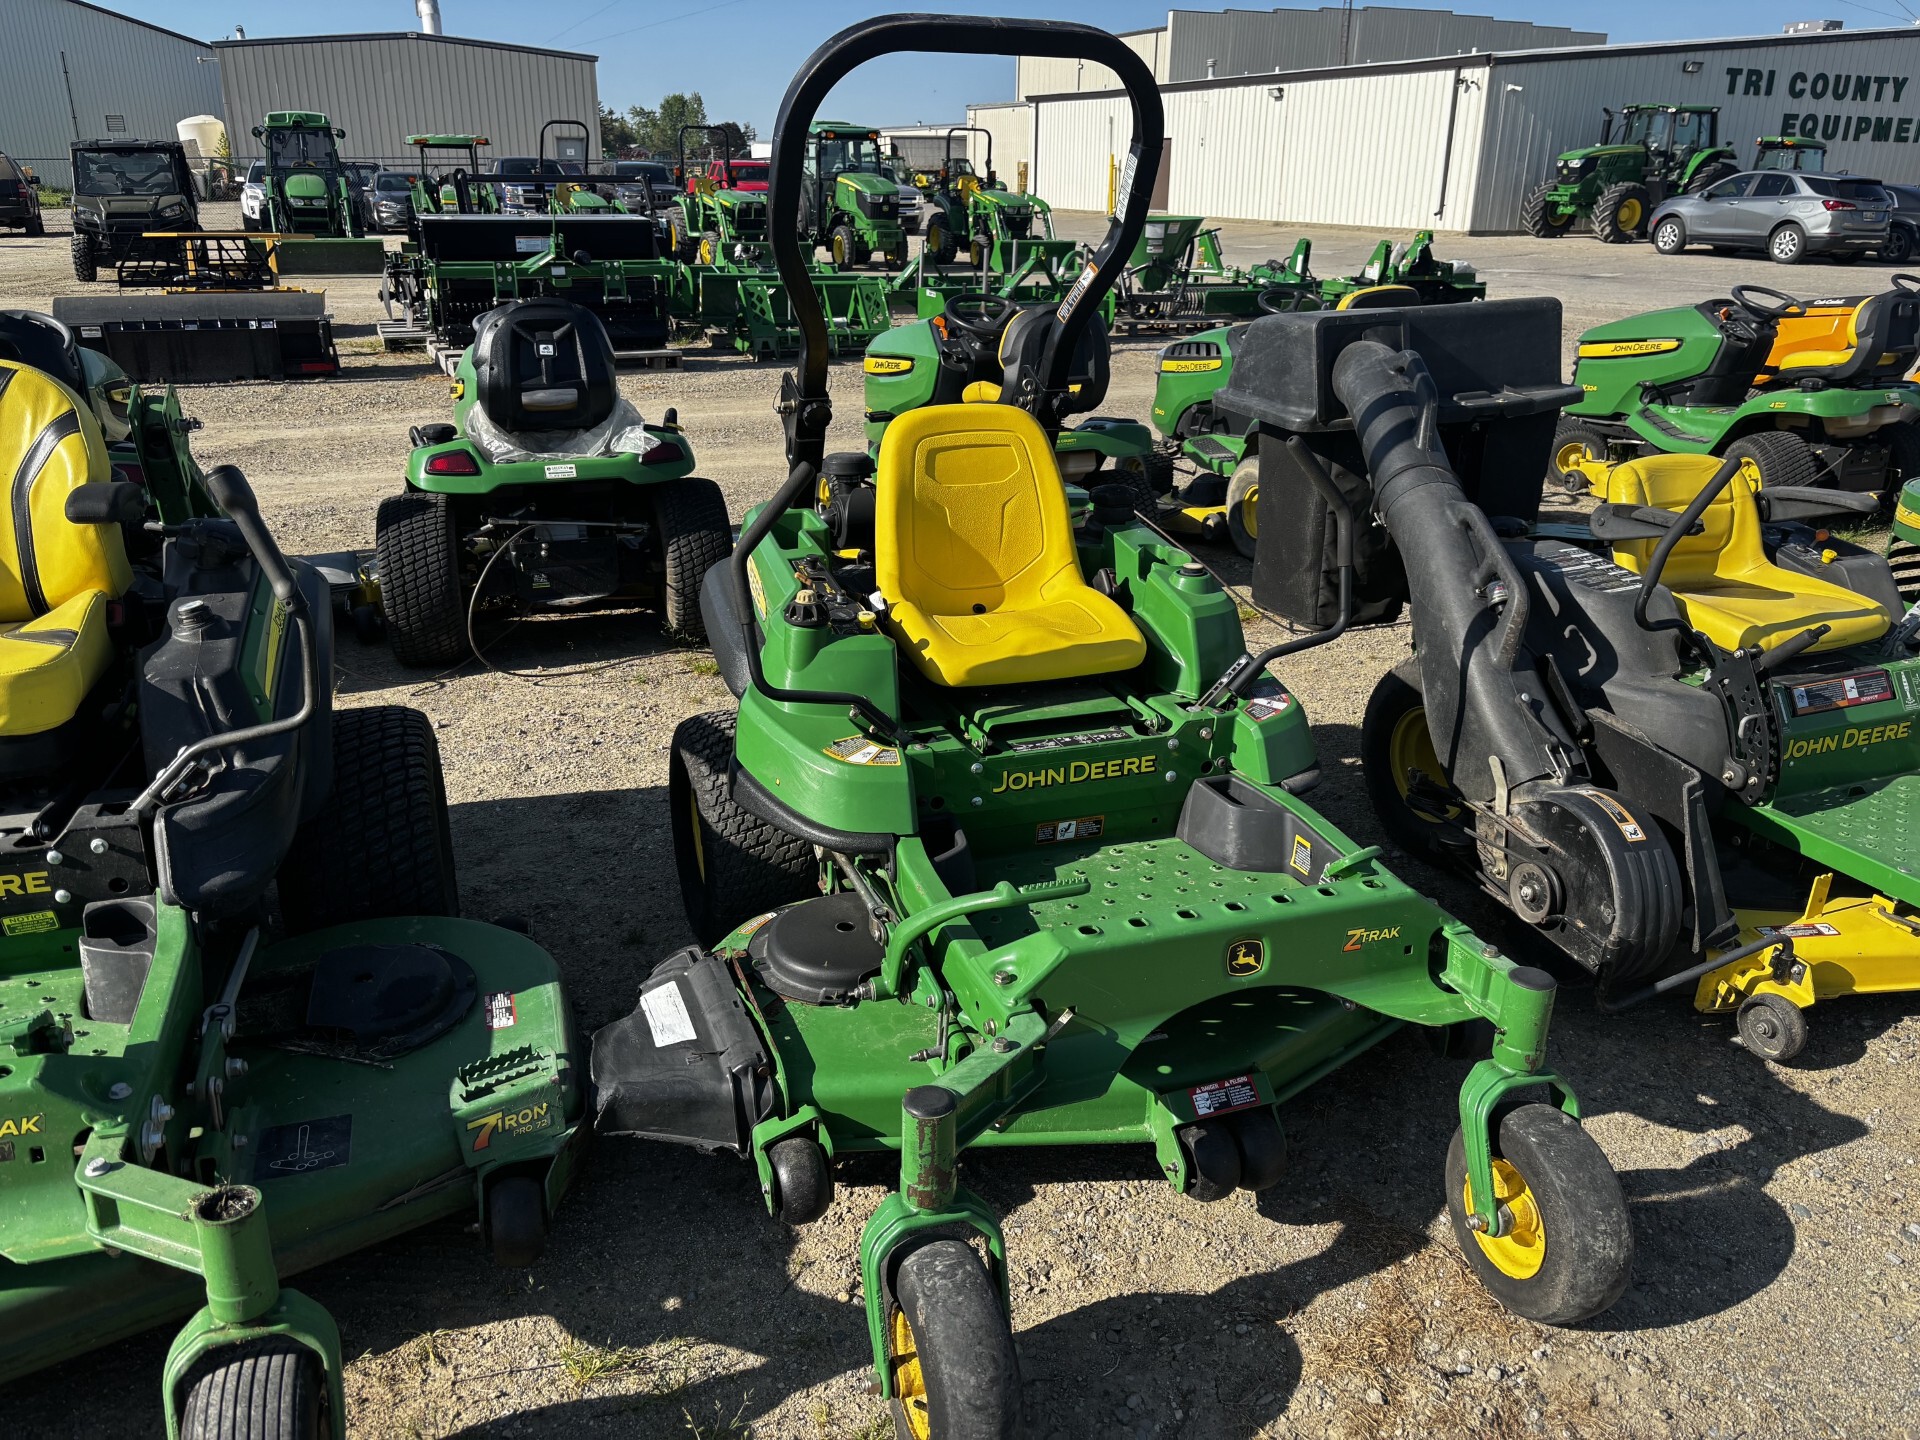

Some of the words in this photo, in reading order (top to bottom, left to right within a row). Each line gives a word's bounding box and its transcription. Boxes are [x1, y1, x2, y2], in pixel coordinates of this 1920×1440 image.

[1726, 67, 1776, 96] TRI
[1788, 71, 1909, 102] COUNTY
[1611, 344, 1633, 353] JOHN
[1633, 343, 1663, 351] DEERE
[873, 360, 885, 369] JOHN
[885, 361, 902, 370] DEERE
[1175, 363, 1190, 371] JOHN
[1190, 362, 1212, 371] DEERE
[1783, 734, 1839, 761] JOHN
[1841, 721, 1912, 749] DEERE
[992, 767, 1065, 794] JOHN
[1069, 755, 1157, 784] DEERE
[9, 912, 49, 924] NOTICE
[513, 1124, 533, 1137] PRO
[536, 1119, 548, 1129] 72
